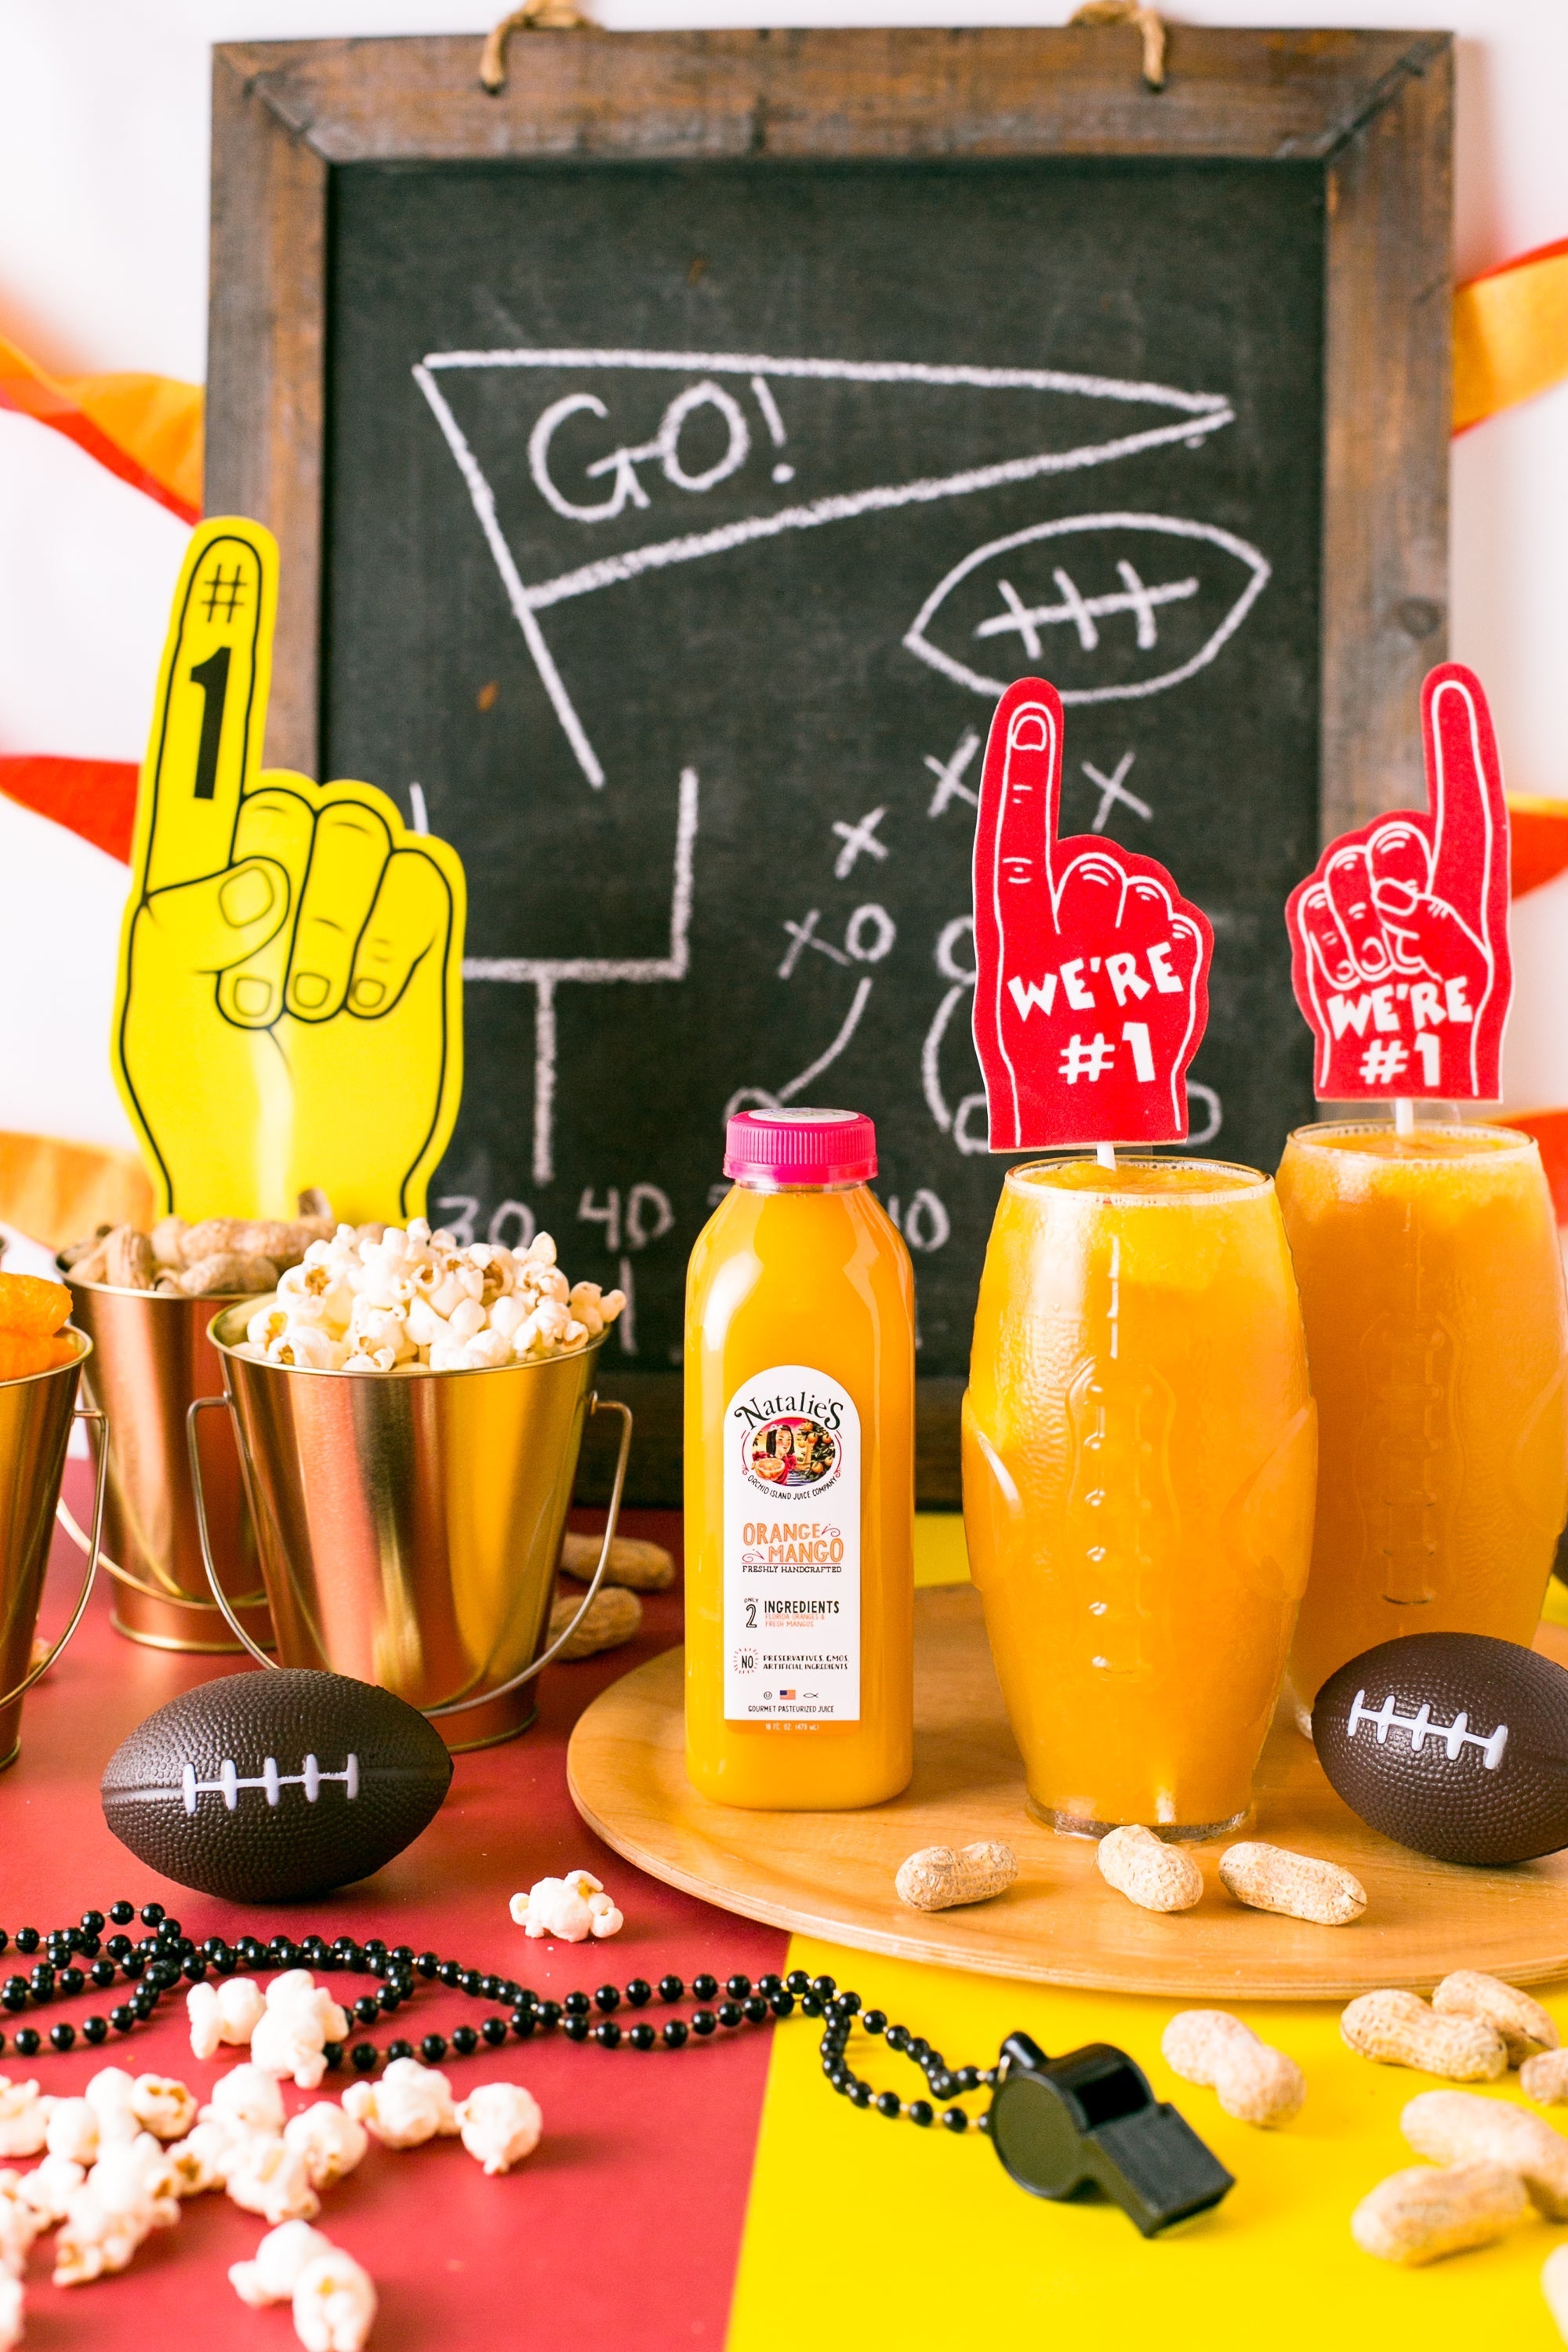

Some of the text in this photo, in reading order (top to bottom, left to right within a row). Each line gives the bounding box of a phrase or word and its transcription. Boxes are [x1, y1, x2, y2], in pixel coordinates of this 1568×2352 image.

[530, 377, 794, 523] GO!
[191, 646, 231, 800] 1
[1007, 942, 1183, 1022] WE'RE
[1327, 977, 1472, 1039] WE'RE
[1058, 1022, 1156, 1084] #1
[1359, 1033, 1441, 1087] #1
[578, 1182, 675, 1252] 40
[770, 1490, 792, 1500] ISLAND
[793, 1490, 811, 1500] JUICE
[812, 1475, 837, 1497] COMPANY
[742, 1523, 821, 1546] ORANGE
[768, 1537, 844, 1563] MANGO
[746, 1600, 840, 1628] 2 INGREDIENTS
[742, 1655, 753, 1668] NO
